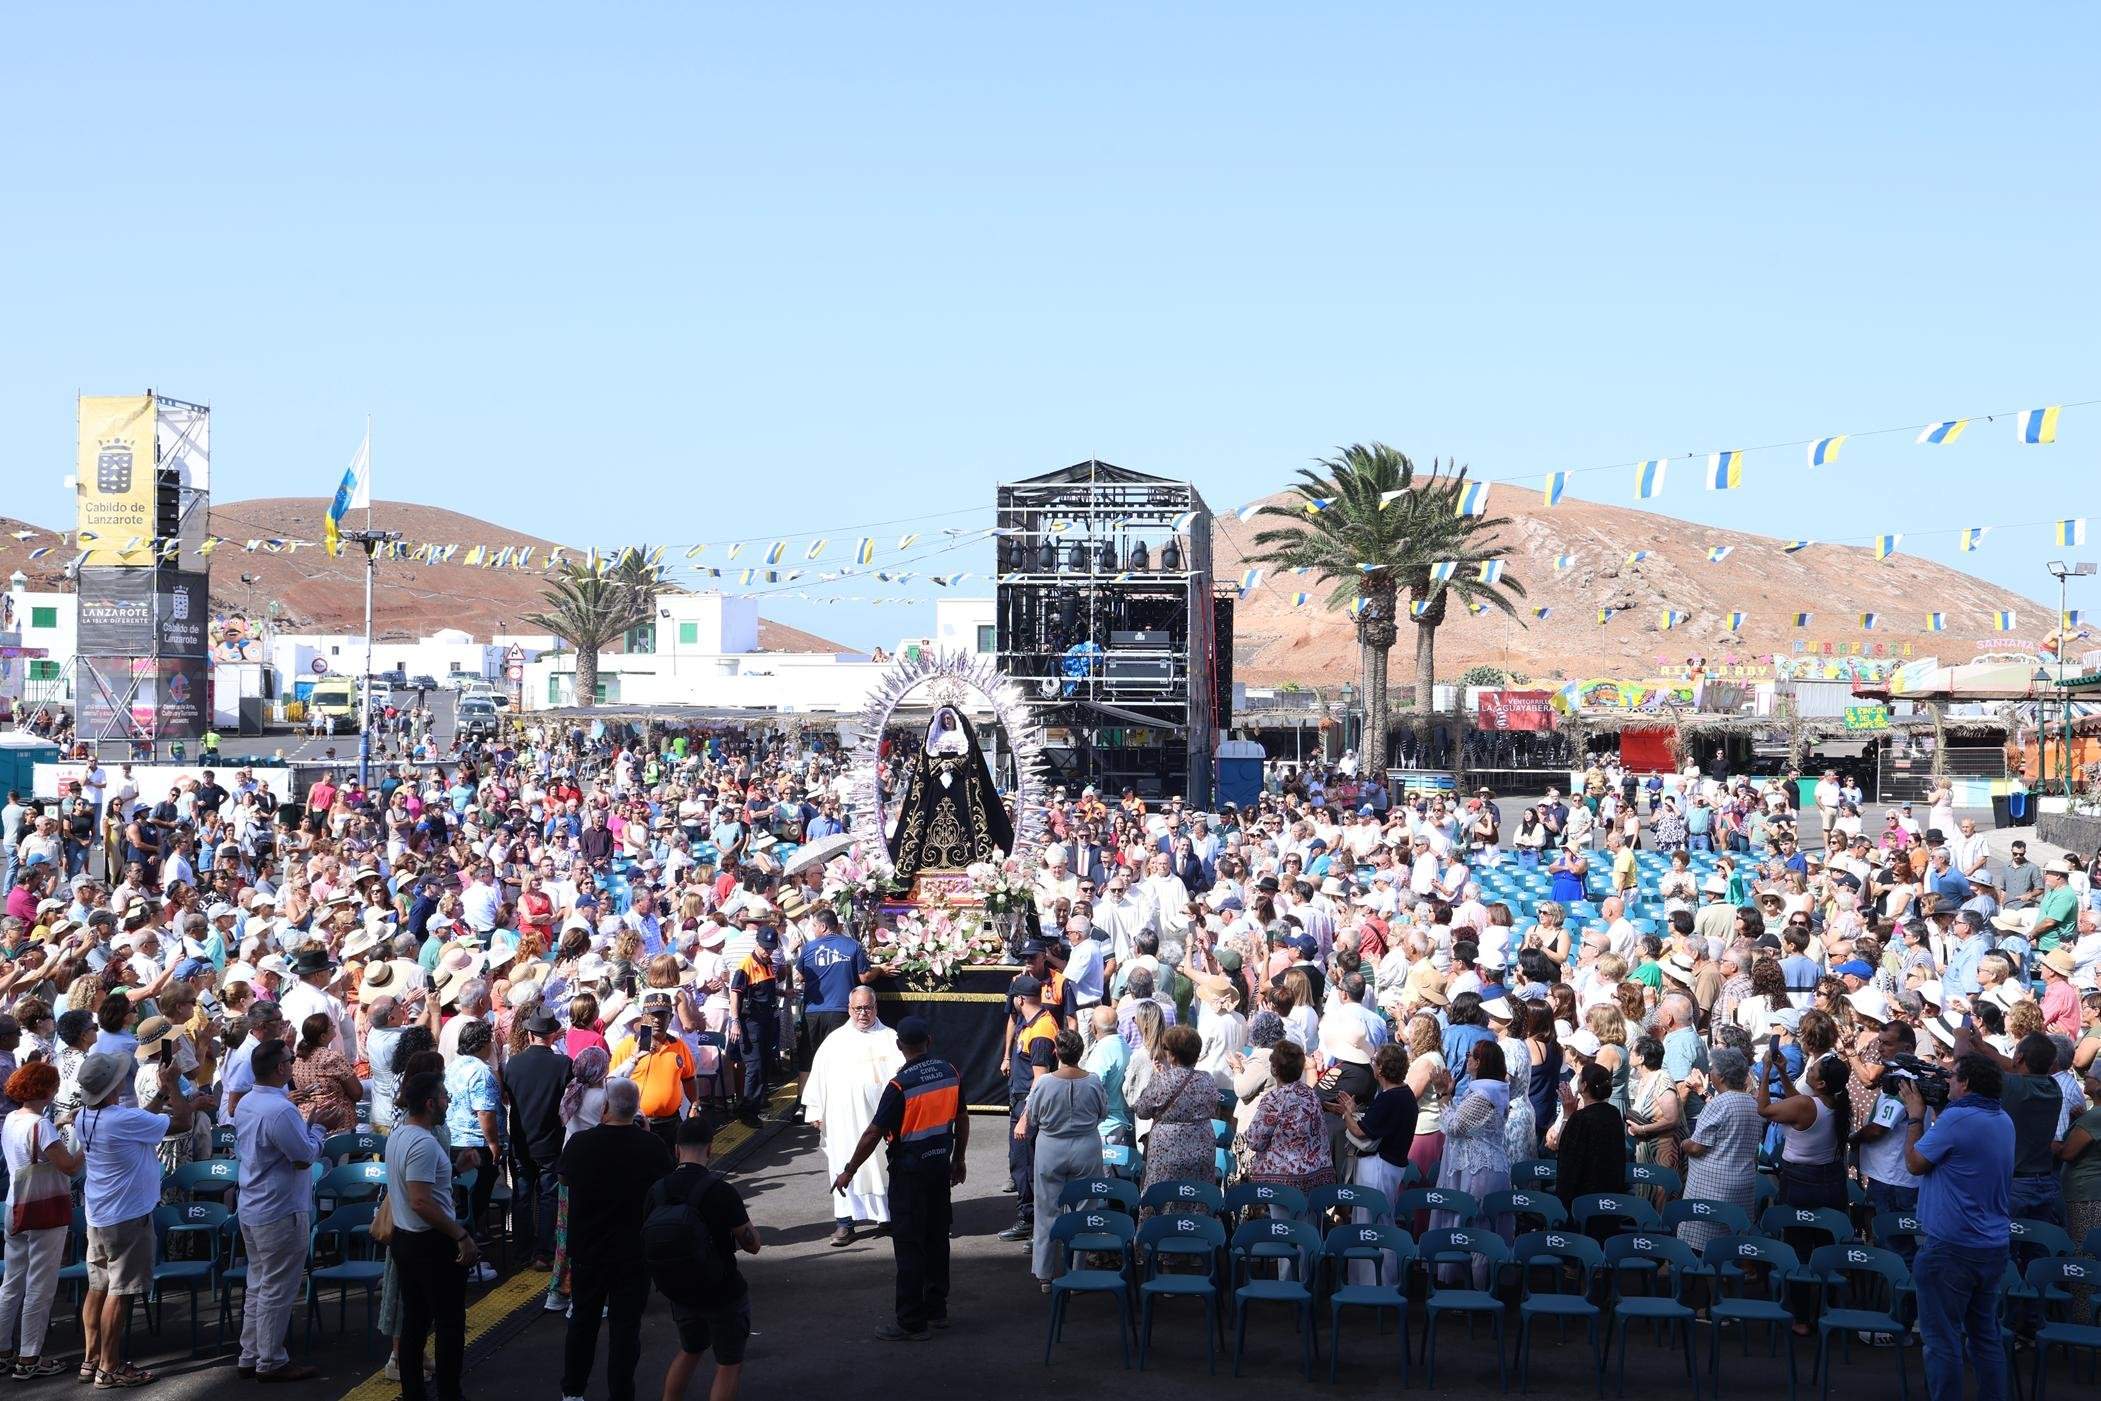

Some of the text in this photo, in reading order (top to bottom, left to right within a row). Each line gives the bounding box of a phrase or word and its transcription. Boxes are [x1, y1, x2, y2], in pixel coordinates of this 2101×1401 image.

[85, 502, 145, 513] Cabildo de
[87, 515, 144, 525] Lanzarote
[82, 608, 149, 617] LANZAROTE
[163, 622, 200, 634] Cabildo de
[164, 634, 198, 644] Lanzarote
[1975, 638, 2034, 650] SANTANA
[1502, 704, 1555, 713] GUAYABERA
[920, 1067, 938, 1075] CIVIL
[920, 1071, 944, 1082] TINAJO
